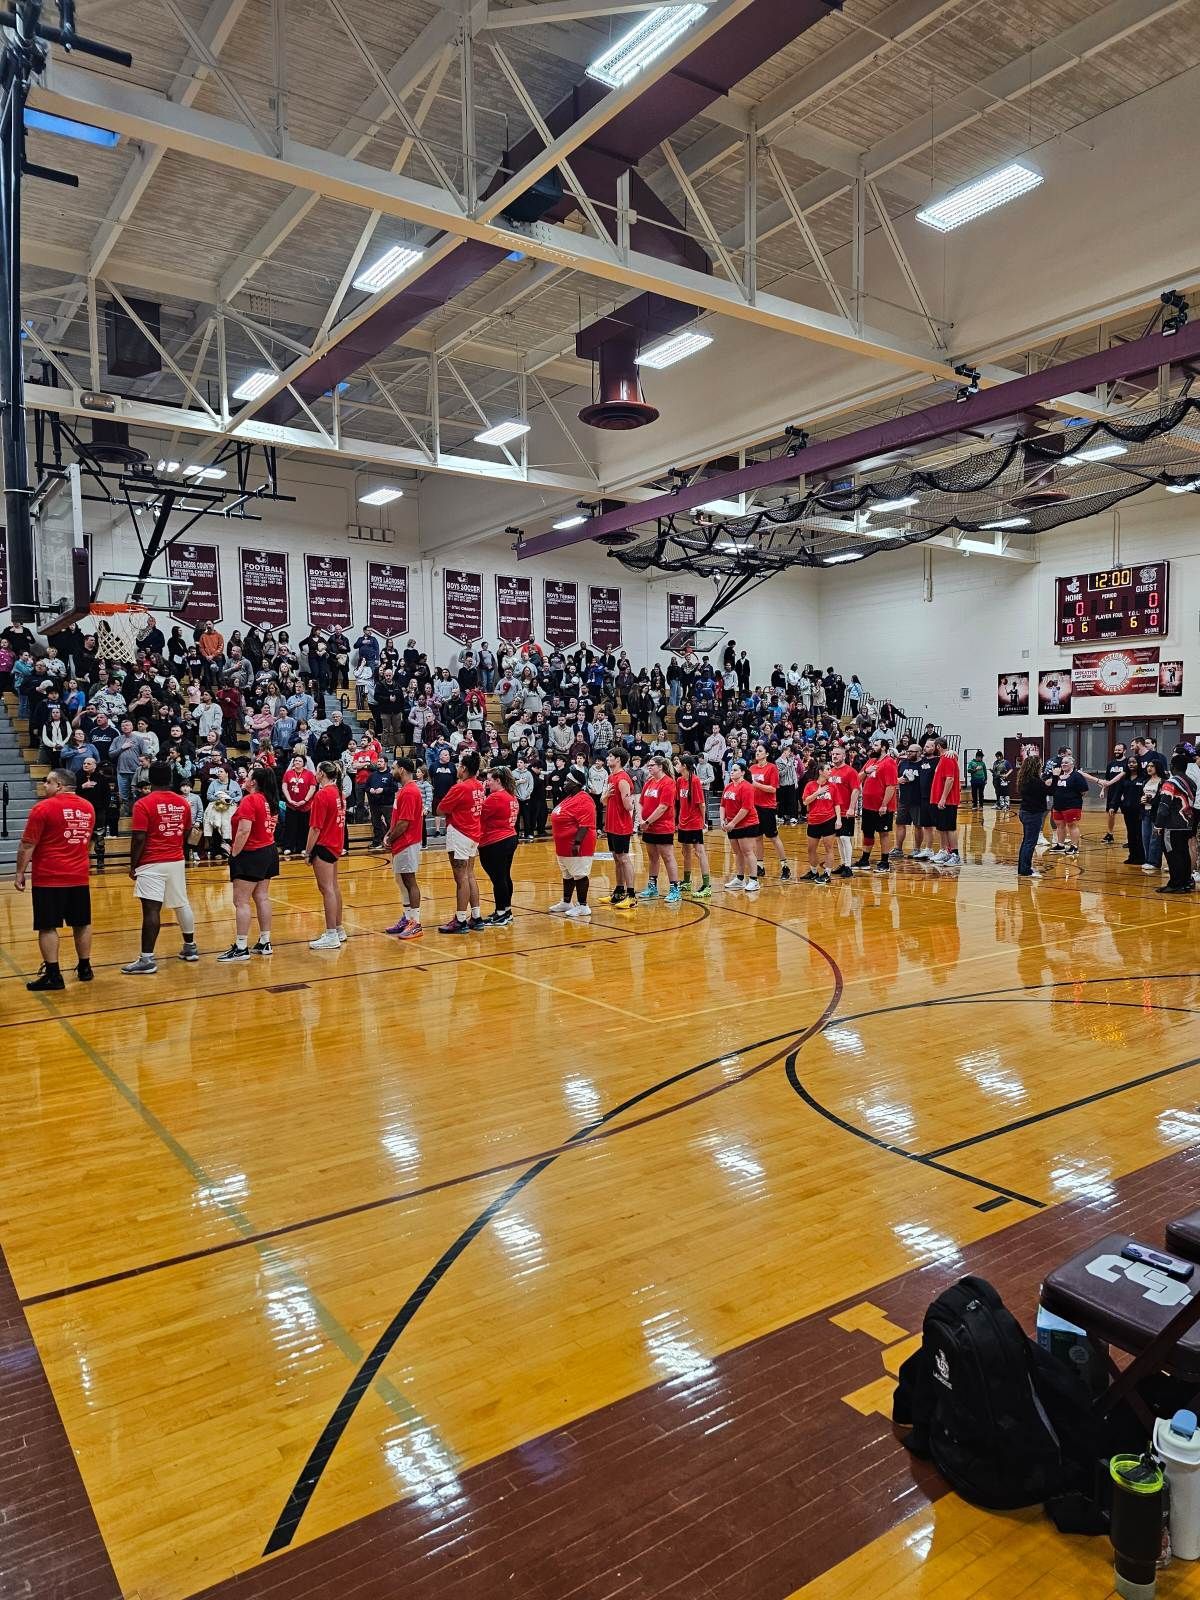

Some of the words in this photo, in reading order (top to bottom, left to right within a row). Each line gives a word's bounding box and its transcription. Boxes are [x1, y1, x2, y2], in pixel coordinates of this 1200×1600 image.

[183, 561, 196, 569] CROSS
[197, 562, 215, 571] COUNTRY
[244, 563, 284, 574] FOOTBALL
[330, 570, 347, 578] GOLF
[1095, 570, 1130, 588] 12:00
[447, 582, 460, 590] BOYS
[461, 584, 481, 593] SOCCER
[1136, 584, 1158, 593] GUEST
[1065, 594, 1083, 602] HOME
[1148, 592, 1158, 608] 0
[1076, 602, 1084, 616] 0
[1130, 616, 1138, 628] 6
[1150, 614, 1158, 626] 0
[1067, 623, 1074, 635] 0
[1081, 622, 1089, 633] 6
